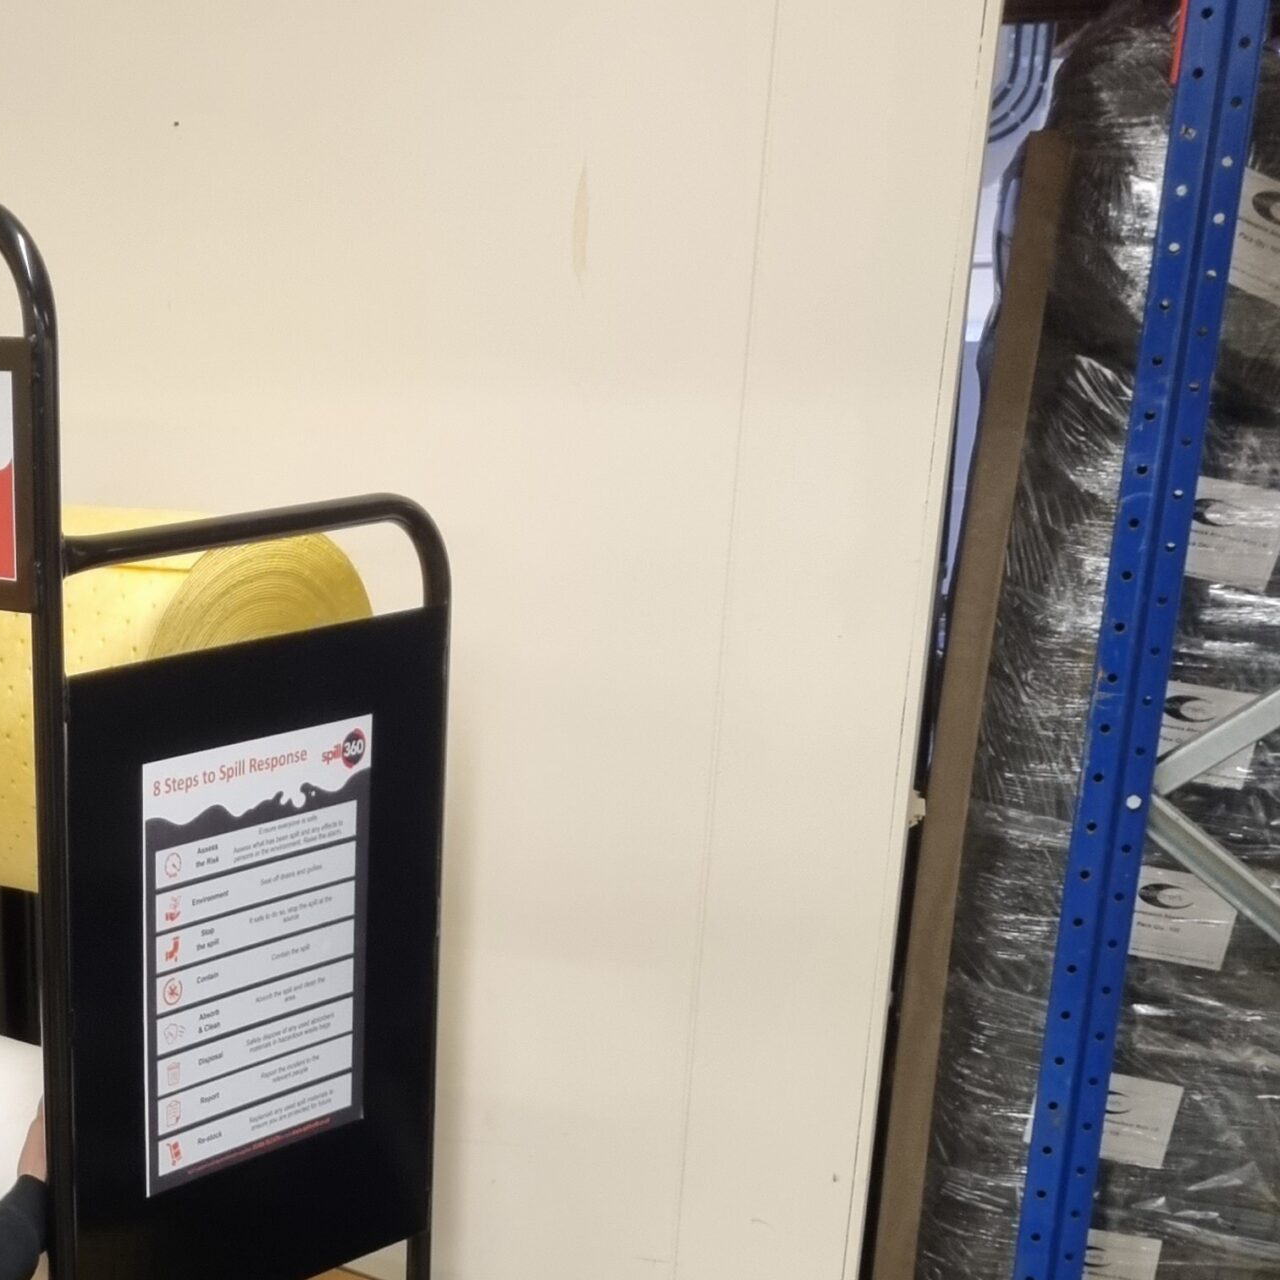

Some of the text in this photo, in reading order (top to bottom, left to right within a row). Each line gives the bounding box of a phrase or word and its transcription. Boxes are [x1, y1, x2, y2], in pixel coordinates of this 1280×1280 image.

[321, 738, 365, 767] spill360
[152, 748, 308, 797] 8 Steps to Spill Response
[196, 844, 219, 855] Assess
[195, 856, 220, 868] the Risk
[191, 890, 230, 907] Environment
[200, 928, 216, 938] Stop
[196, 938, 220, 952] the spill
[196, 972, 220, 985] Contain
[199, 1009, 220, 1021] Absorb
[204, 1021, 221, 1032] Clean
[198, 1051, 224, 1066] Disposal
[200, 1092, 221, 1104] Report
[197, 1131, 223, 1145] Re-stock
